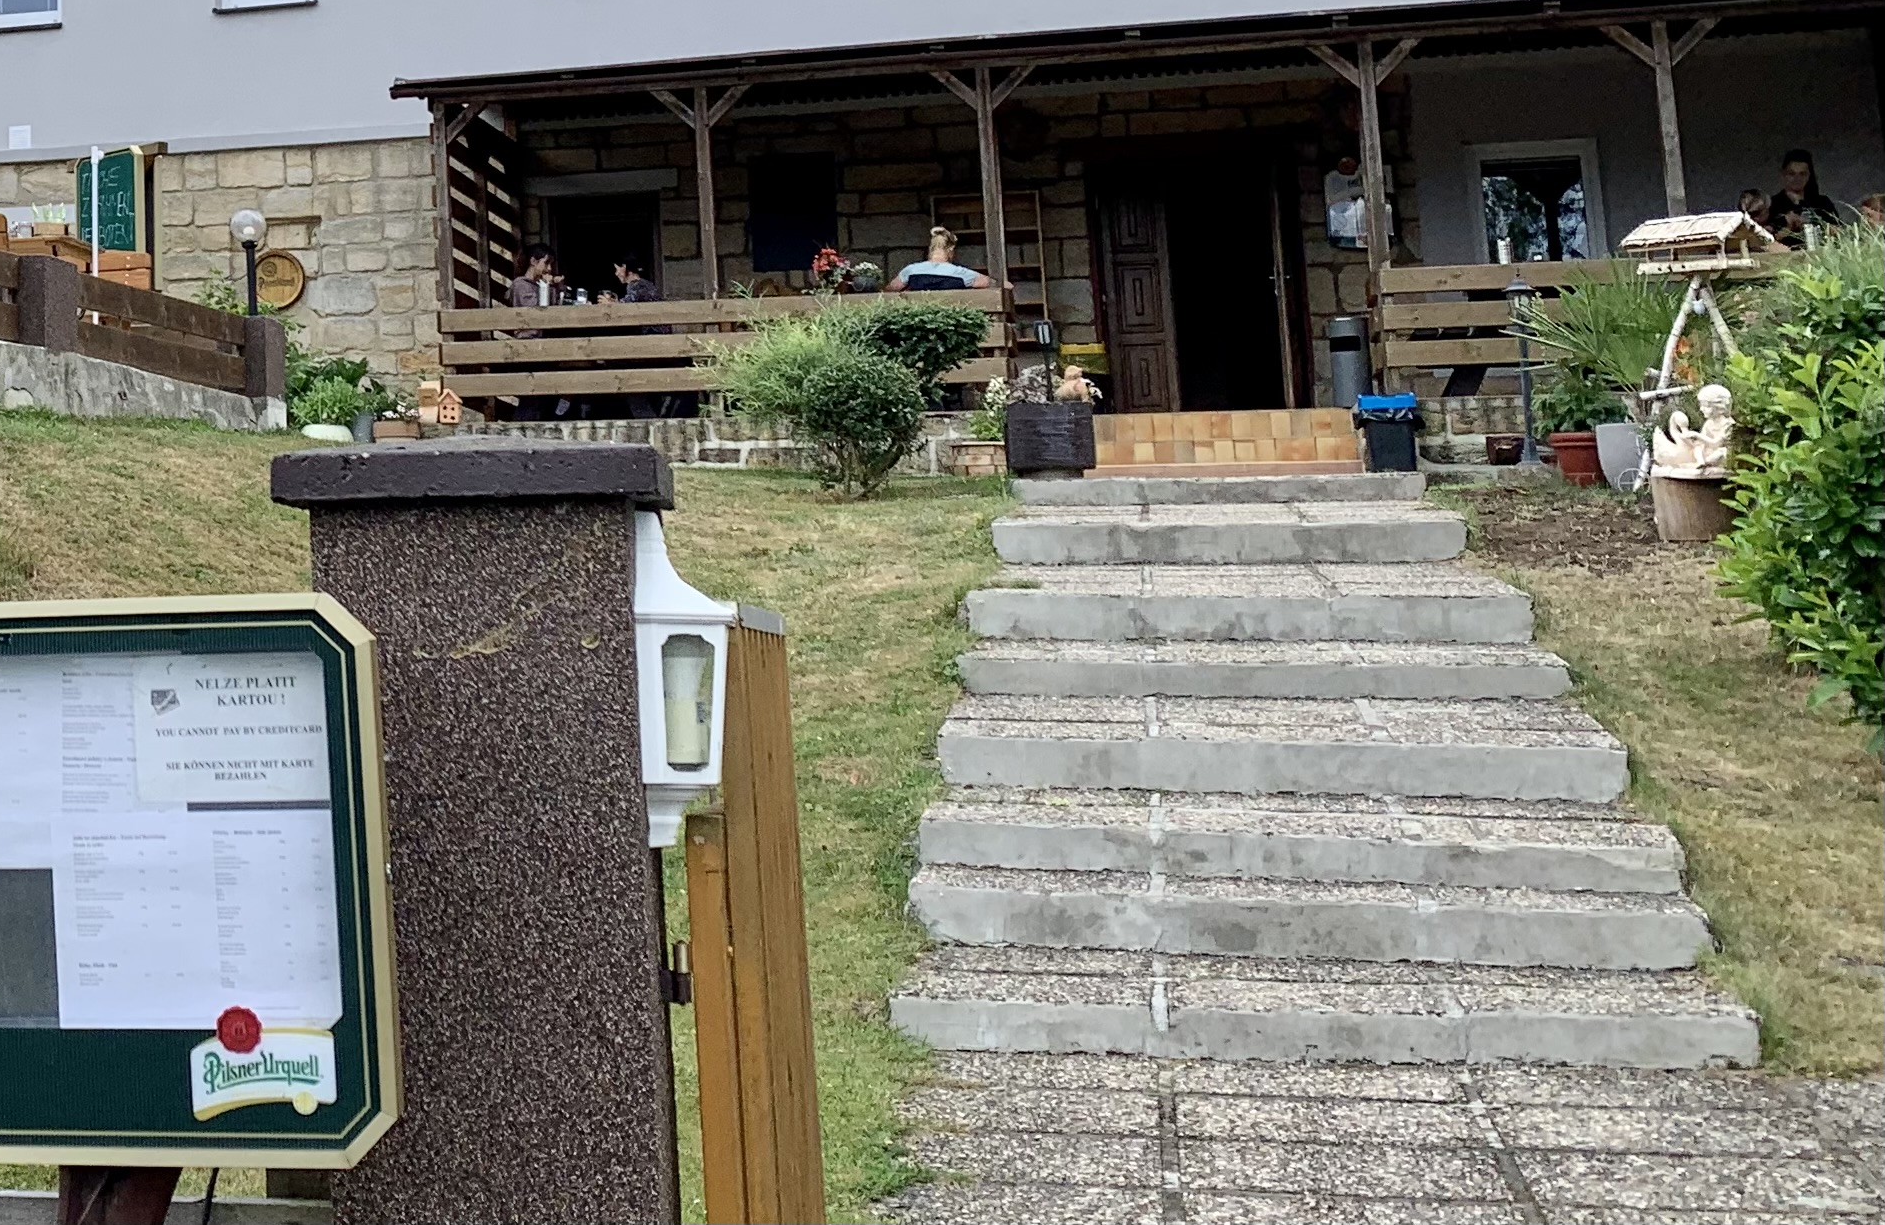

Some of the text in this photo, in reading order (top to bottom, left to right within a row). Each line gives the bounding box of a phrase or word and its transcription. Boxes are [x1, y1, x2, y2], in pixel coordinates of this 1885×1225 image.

[195, 677, 242, 691] NELZE
[217, 693, 277, 707] KARTOU
[155, 727, 174, 738] YOU
[178, 726, 219, 737] CANNOT
[223, 725, 241, 736] PAY
[243, 725, 256, 735] BY
[166, 758, 315, 771] SIE KÖNNEN NICHT MIT KARTE
[214, 770, 267, 781] BEZAHLEN
[203, 1050, 320, 1095] Pilsner Urquell
